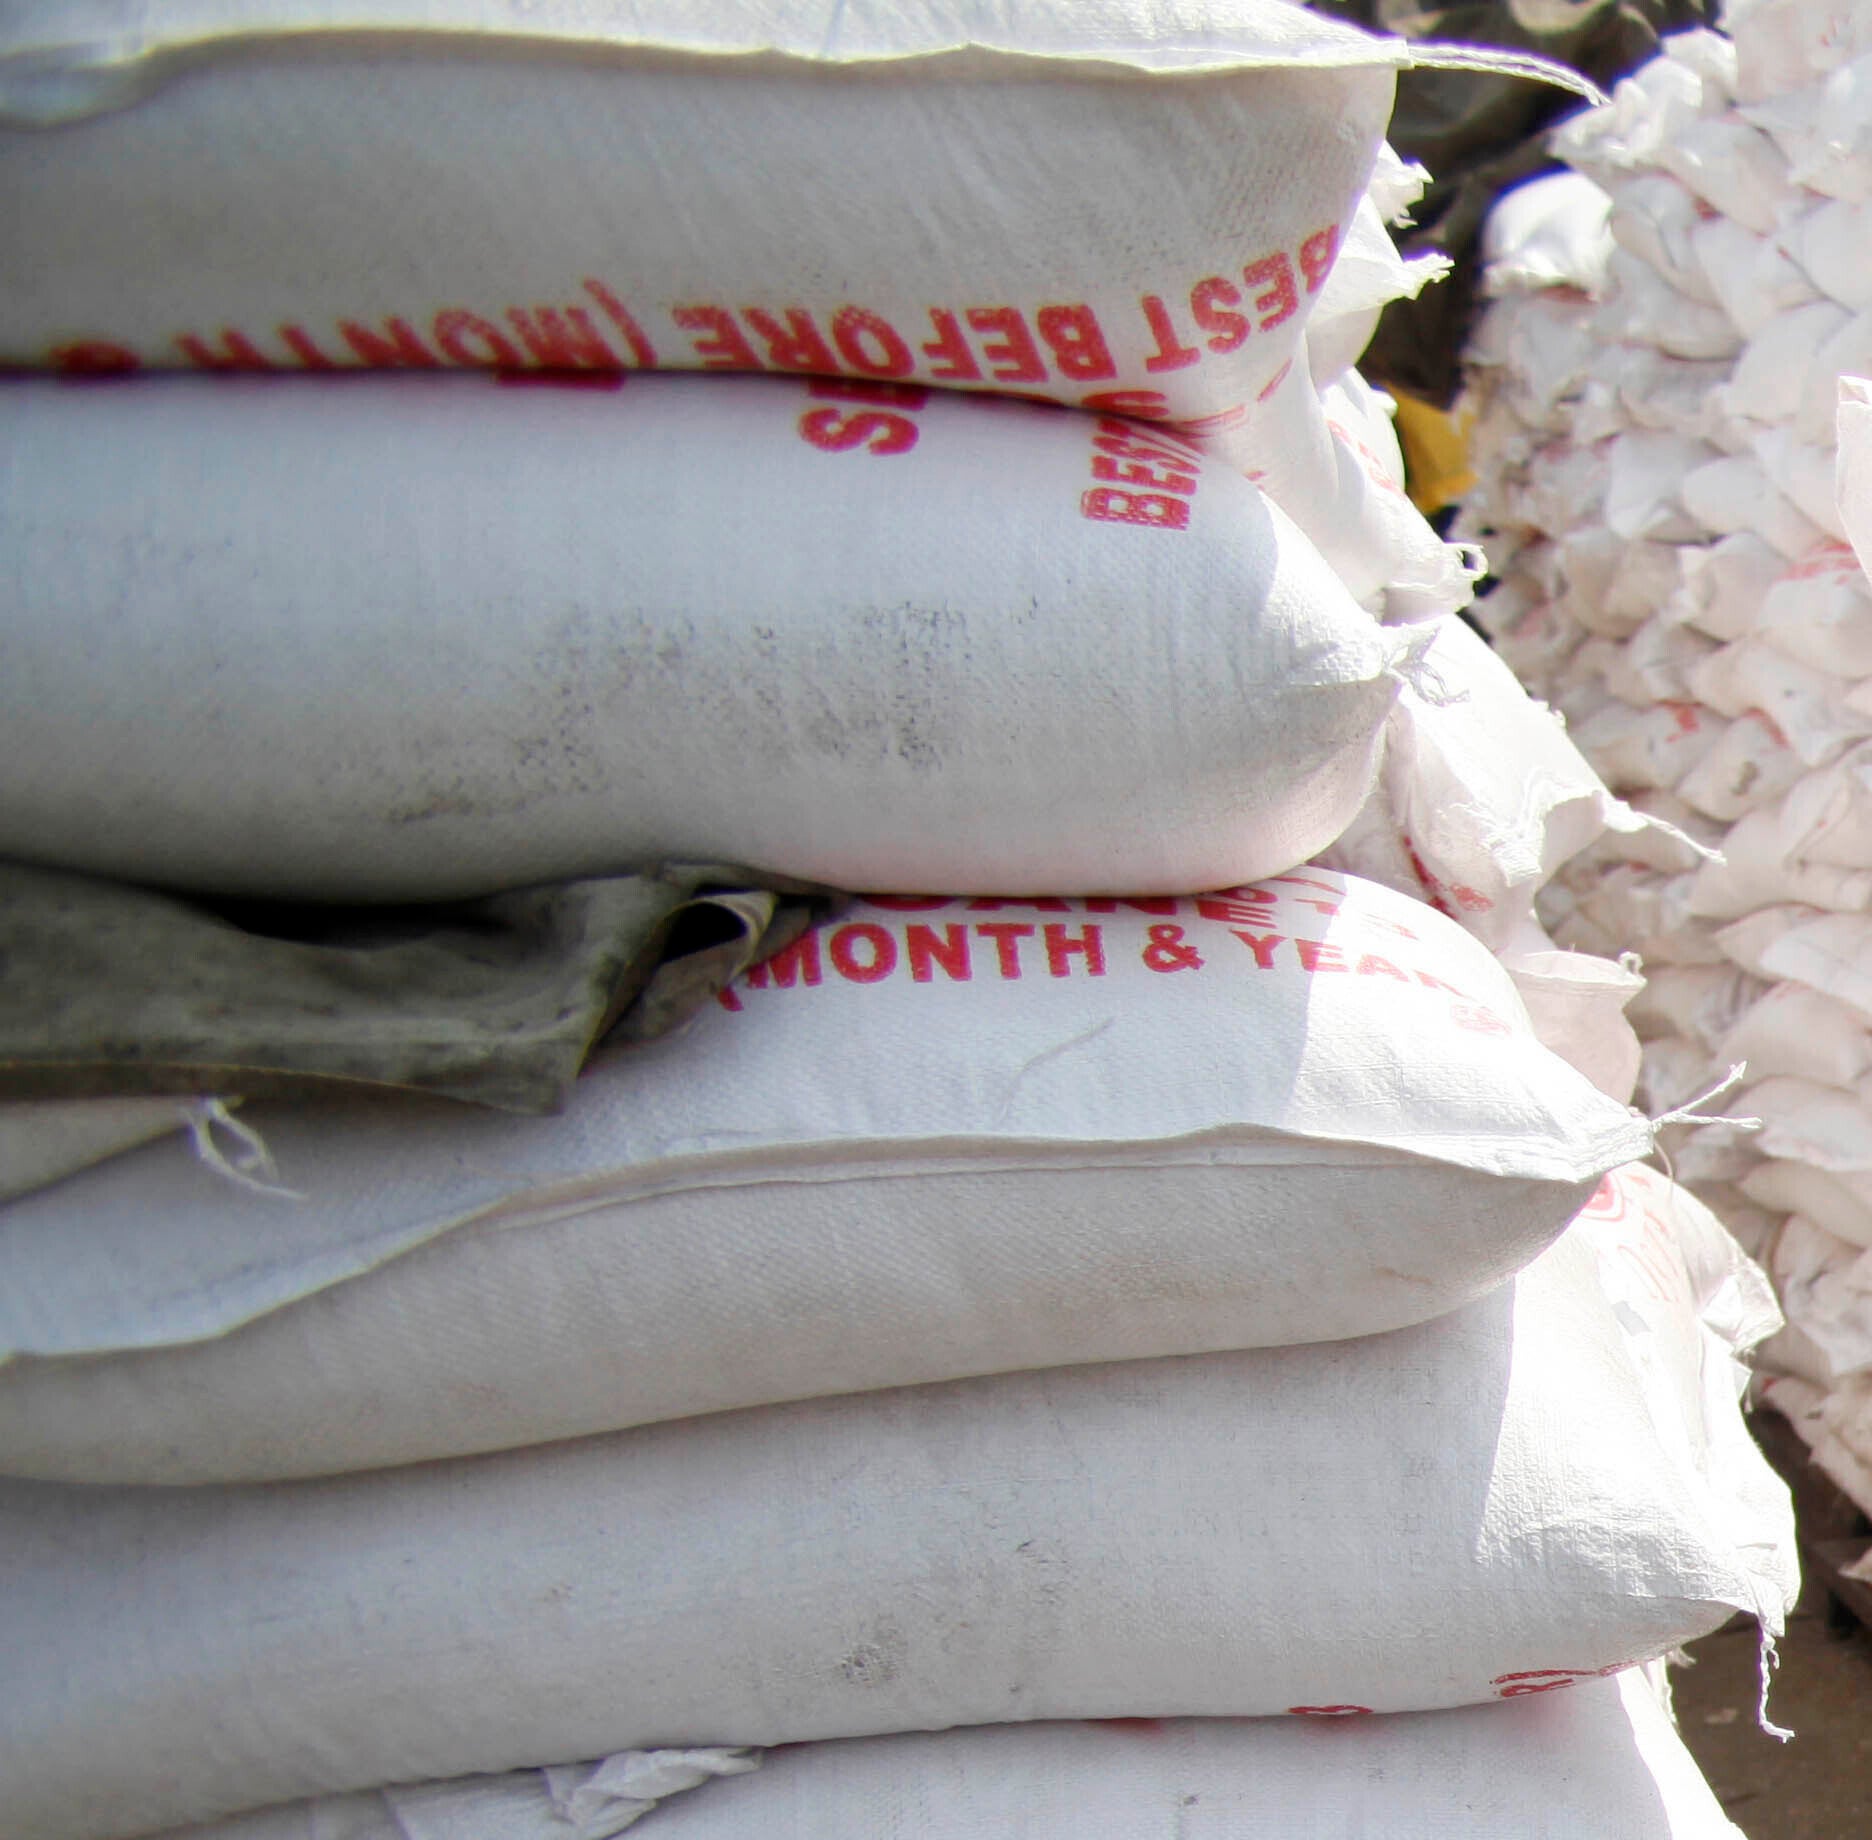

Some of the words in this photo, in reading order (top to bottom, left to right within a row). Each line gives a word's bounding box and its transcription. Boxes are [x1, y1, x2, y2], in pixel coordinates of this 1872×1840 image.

[673, 304, 1118, 382] BEFORE
[1144, 224, 1340, 374] BEST
[718, 922, 1107, 1012] MONTH
[1142, 924, 1204, 972] &
